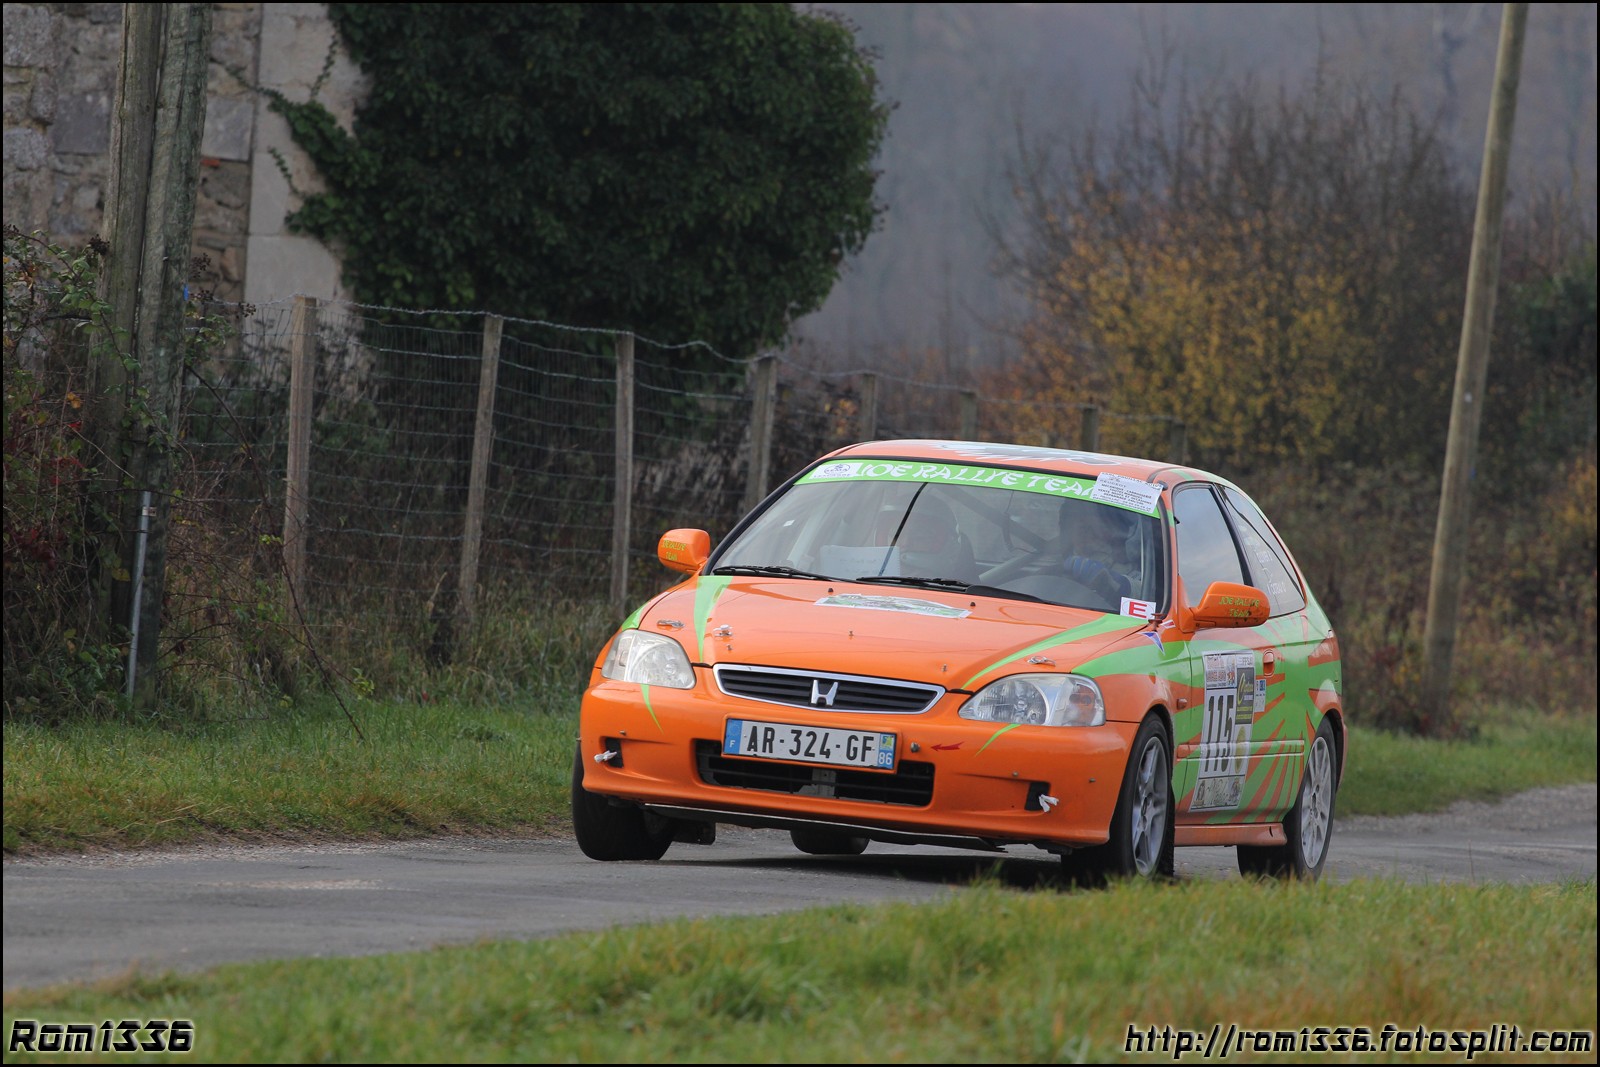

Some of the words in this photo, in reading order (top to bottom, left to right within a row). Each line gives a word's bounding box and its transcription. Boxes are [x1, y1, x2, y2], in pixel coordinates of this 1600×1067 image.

[912, 464, 1025, 486] RALLYE
[1219, 596, 1234, 605] JOE
[1128, 601, 1148, 619] E
[1204, 694, 1235, 773] 115
[729, 740, 735, 748] F
[747, 725, 874, 763] AR-324-GF
[878, 752, 893, 766] 86
